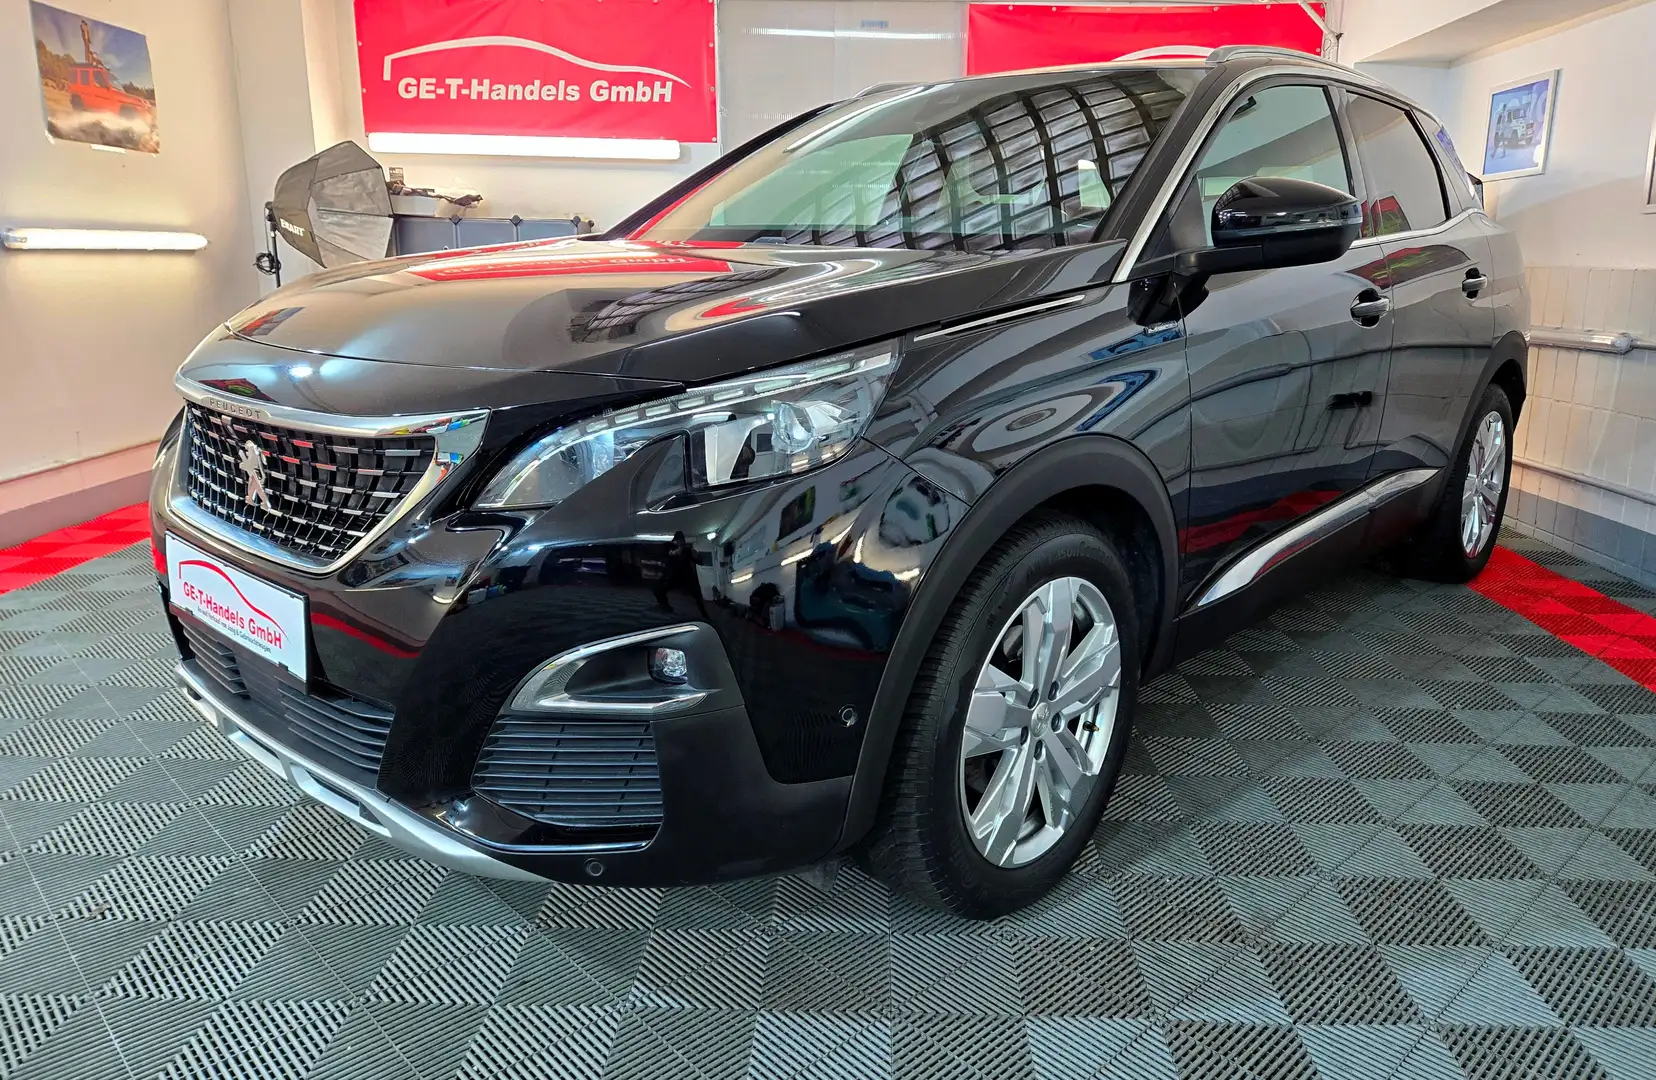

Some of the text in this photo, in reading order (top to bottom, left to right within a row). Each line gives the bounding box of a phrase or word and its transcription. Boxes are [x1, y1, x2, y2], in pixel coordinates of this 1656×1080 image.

[398, 77, 673, 102] GE-T-Handels GmbH
[209, 398, 261, 419] PEUGEOT
[183, 581, 282, 650] GE-T-Handels GmbH
